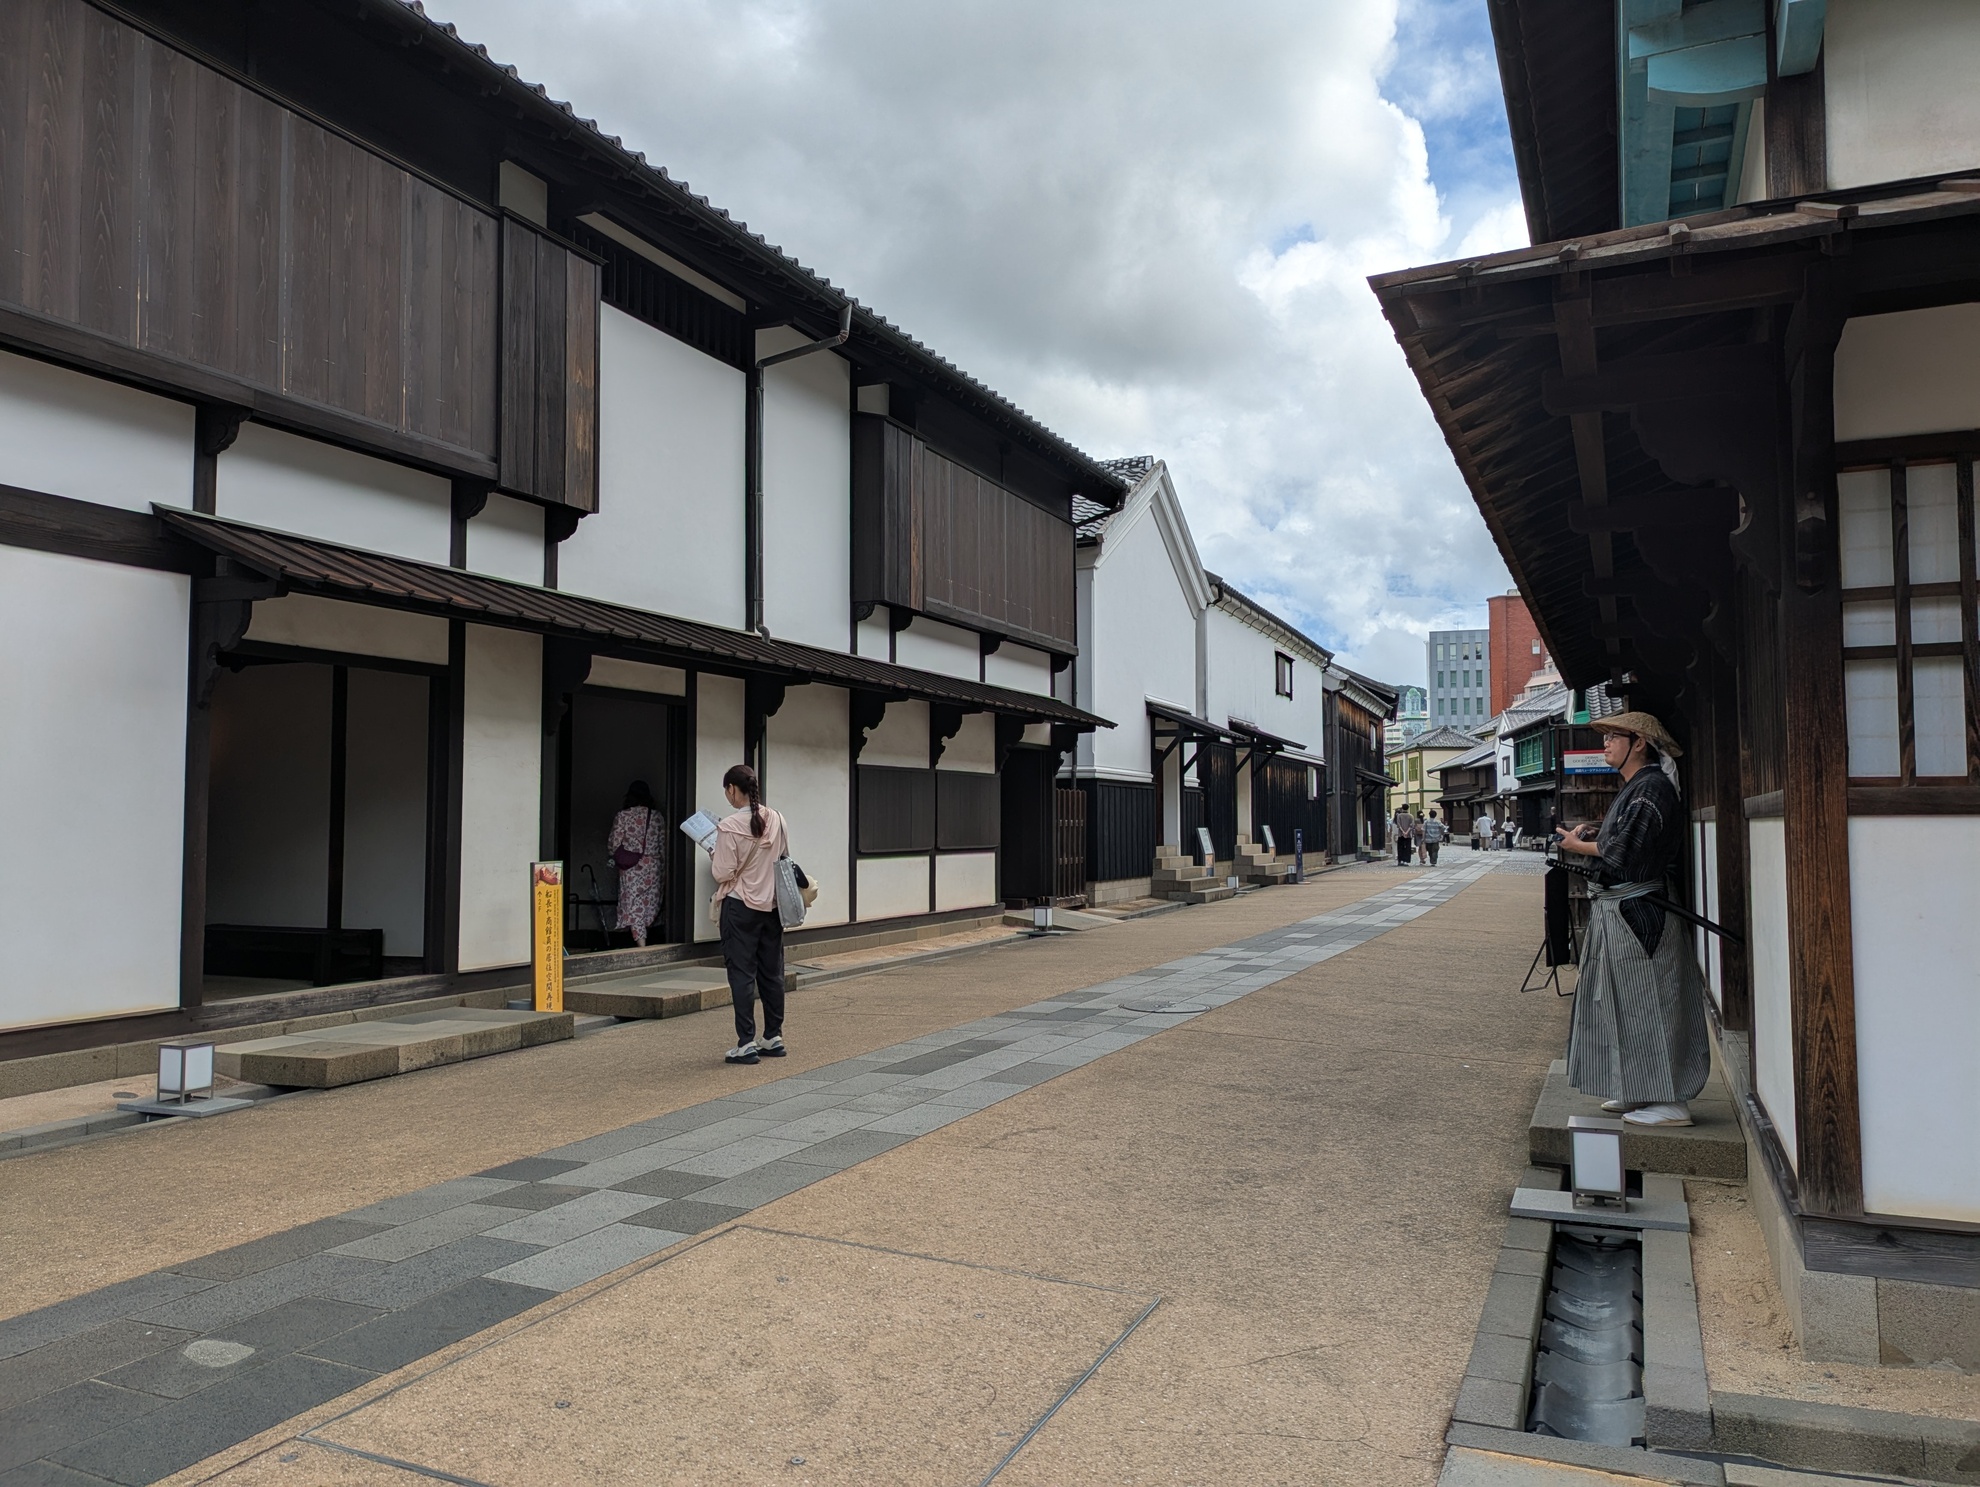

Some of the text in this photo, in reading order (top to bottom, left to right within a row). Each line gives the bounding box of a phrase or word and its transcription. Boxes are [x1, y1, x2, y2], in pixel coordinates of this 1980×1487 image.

[545, 890, 553, 1010] 船長や商館員の居住空間再現
